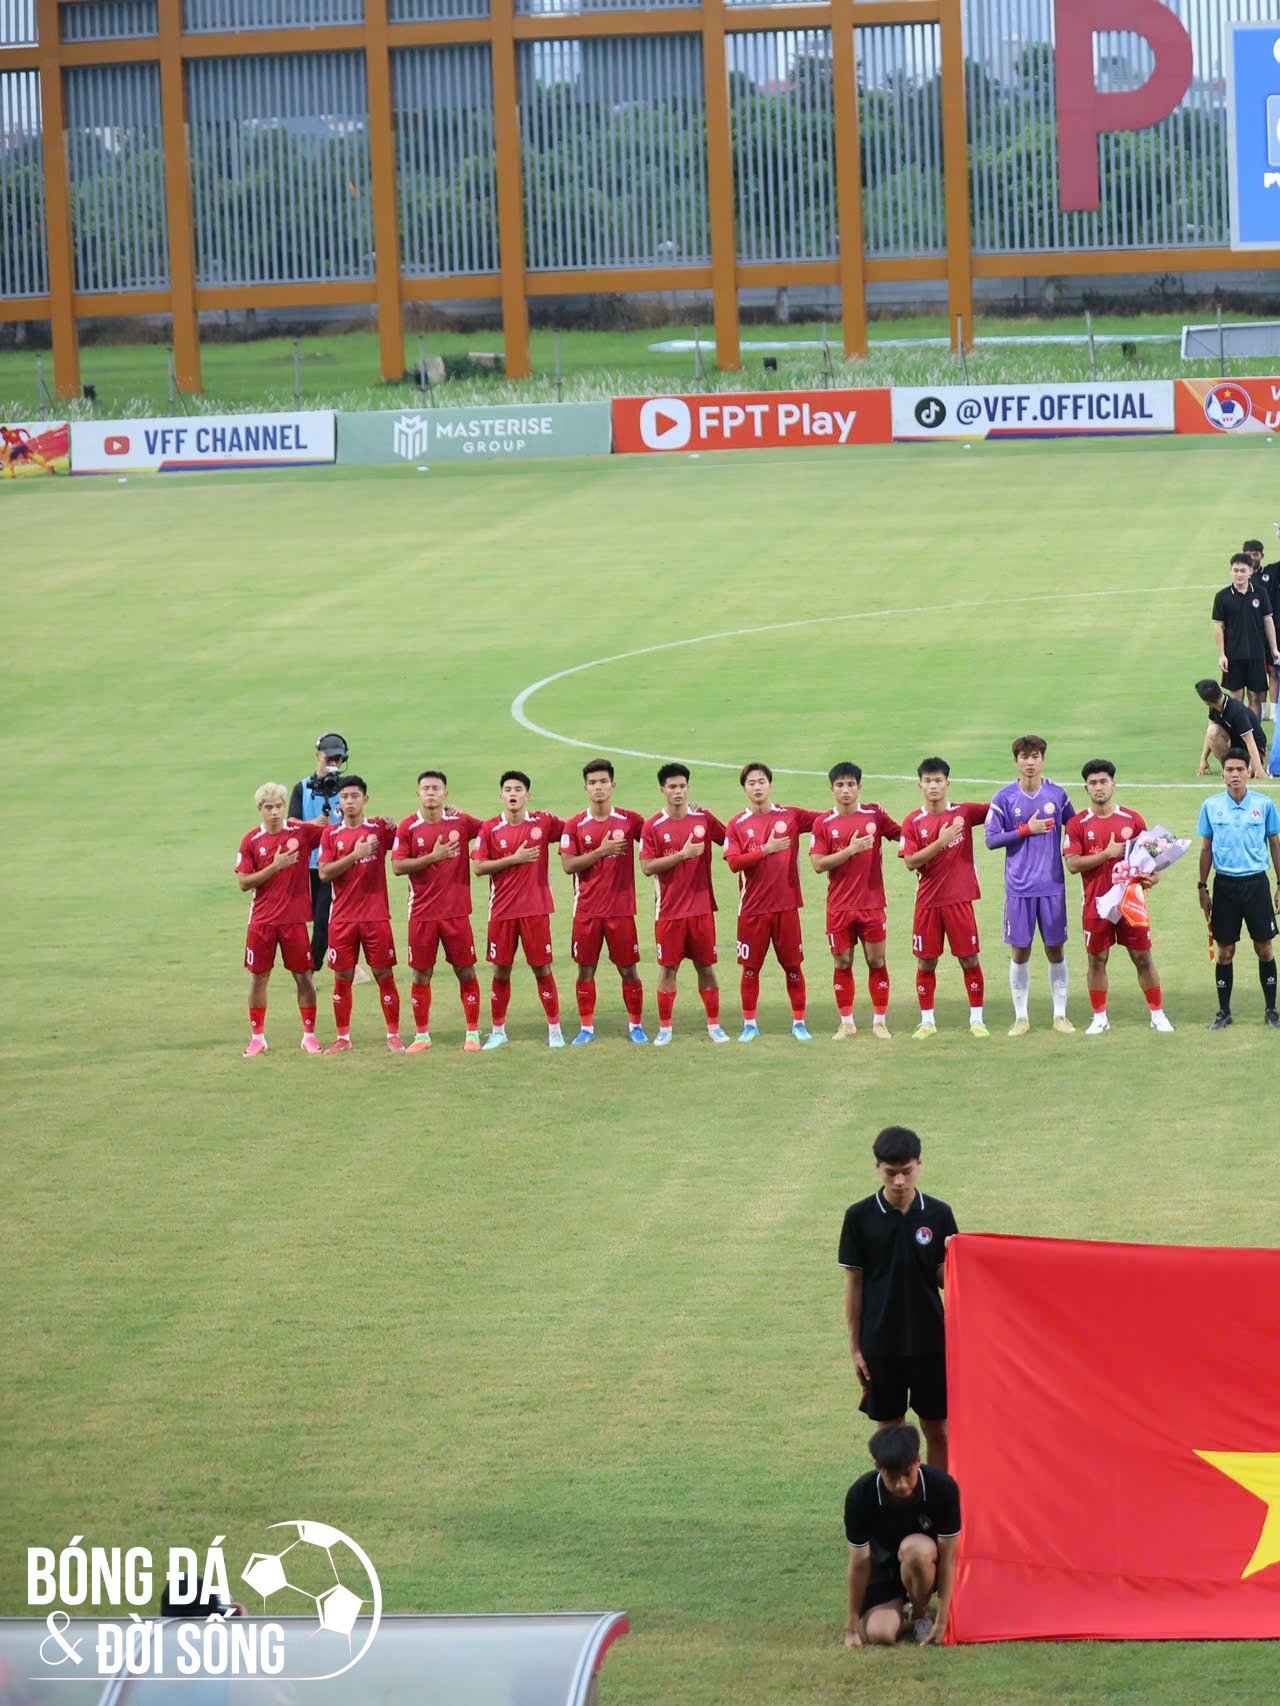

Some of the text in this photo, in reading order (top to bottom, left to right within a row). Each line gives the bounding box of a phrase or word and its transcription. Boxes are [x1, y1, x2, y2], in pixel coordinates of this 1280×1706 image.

[699, 402, 857, 443] FPT Play
[957, 392, 1153, 426] @VFF.OFFICIAL
[145, 424, 308, 456] VFF CHANNEL
[436, 417, 553, 437] MASTERISE
[463, 439, 526, 454] GROUP
